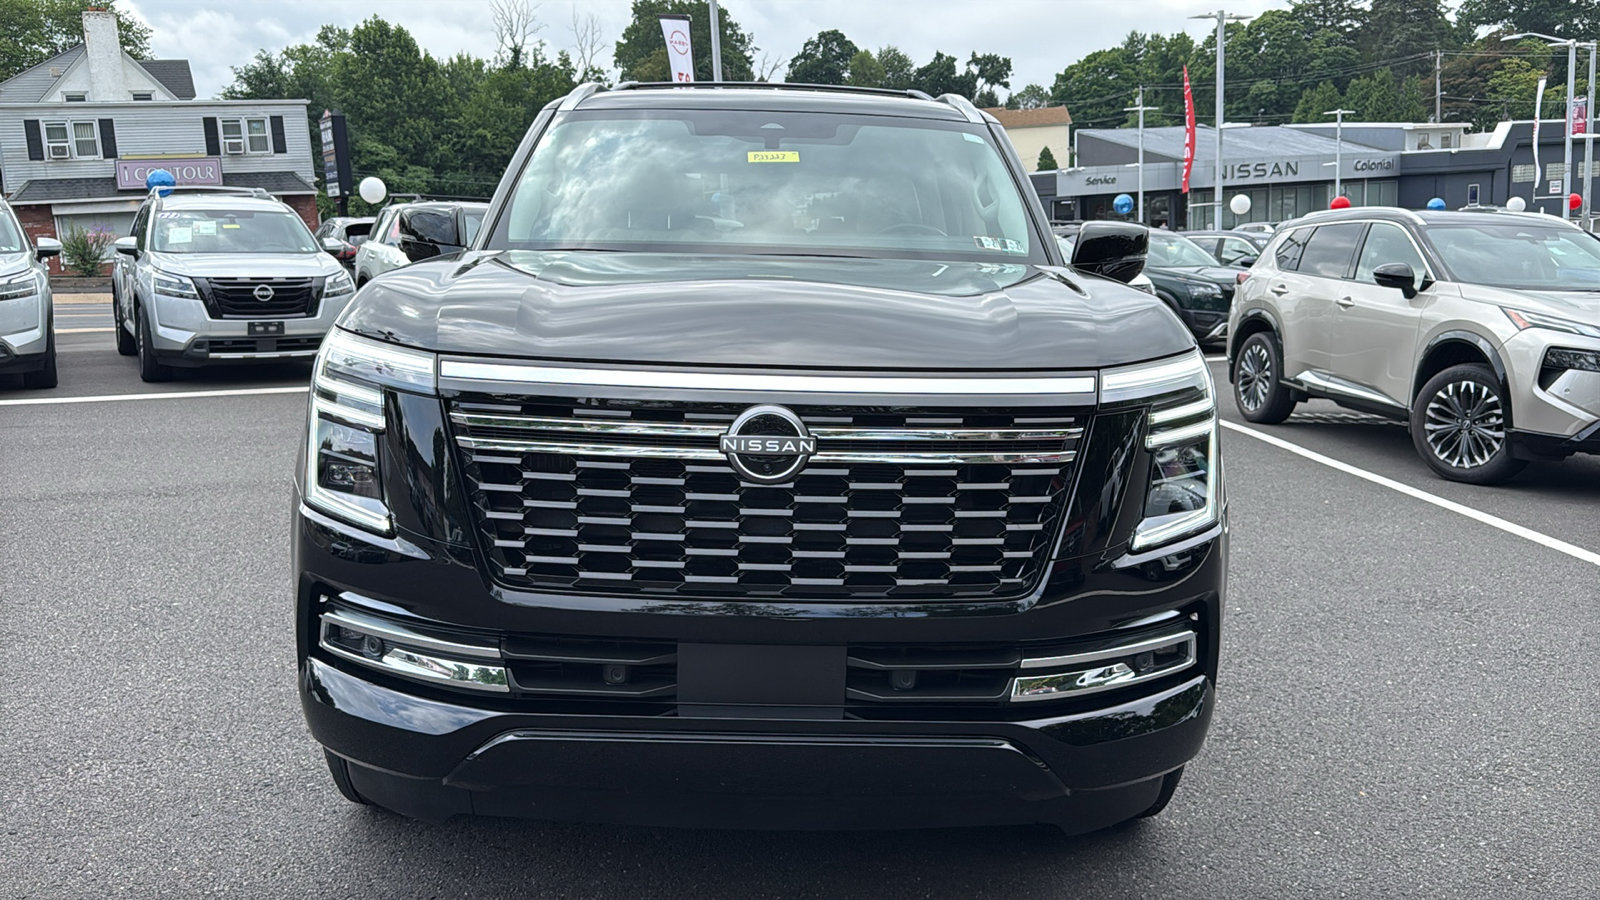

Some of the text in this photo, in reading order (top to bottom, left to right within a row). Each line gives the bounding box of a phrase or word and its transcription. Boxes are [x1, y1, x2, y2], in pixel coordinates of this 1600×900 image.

[1354, 158, 1394, 171] Colonial
[134, 166, 214, 181] CTOUR
[1085, 175, 1117, 186] Service
[723, 438, 814, 453] NISSAN
